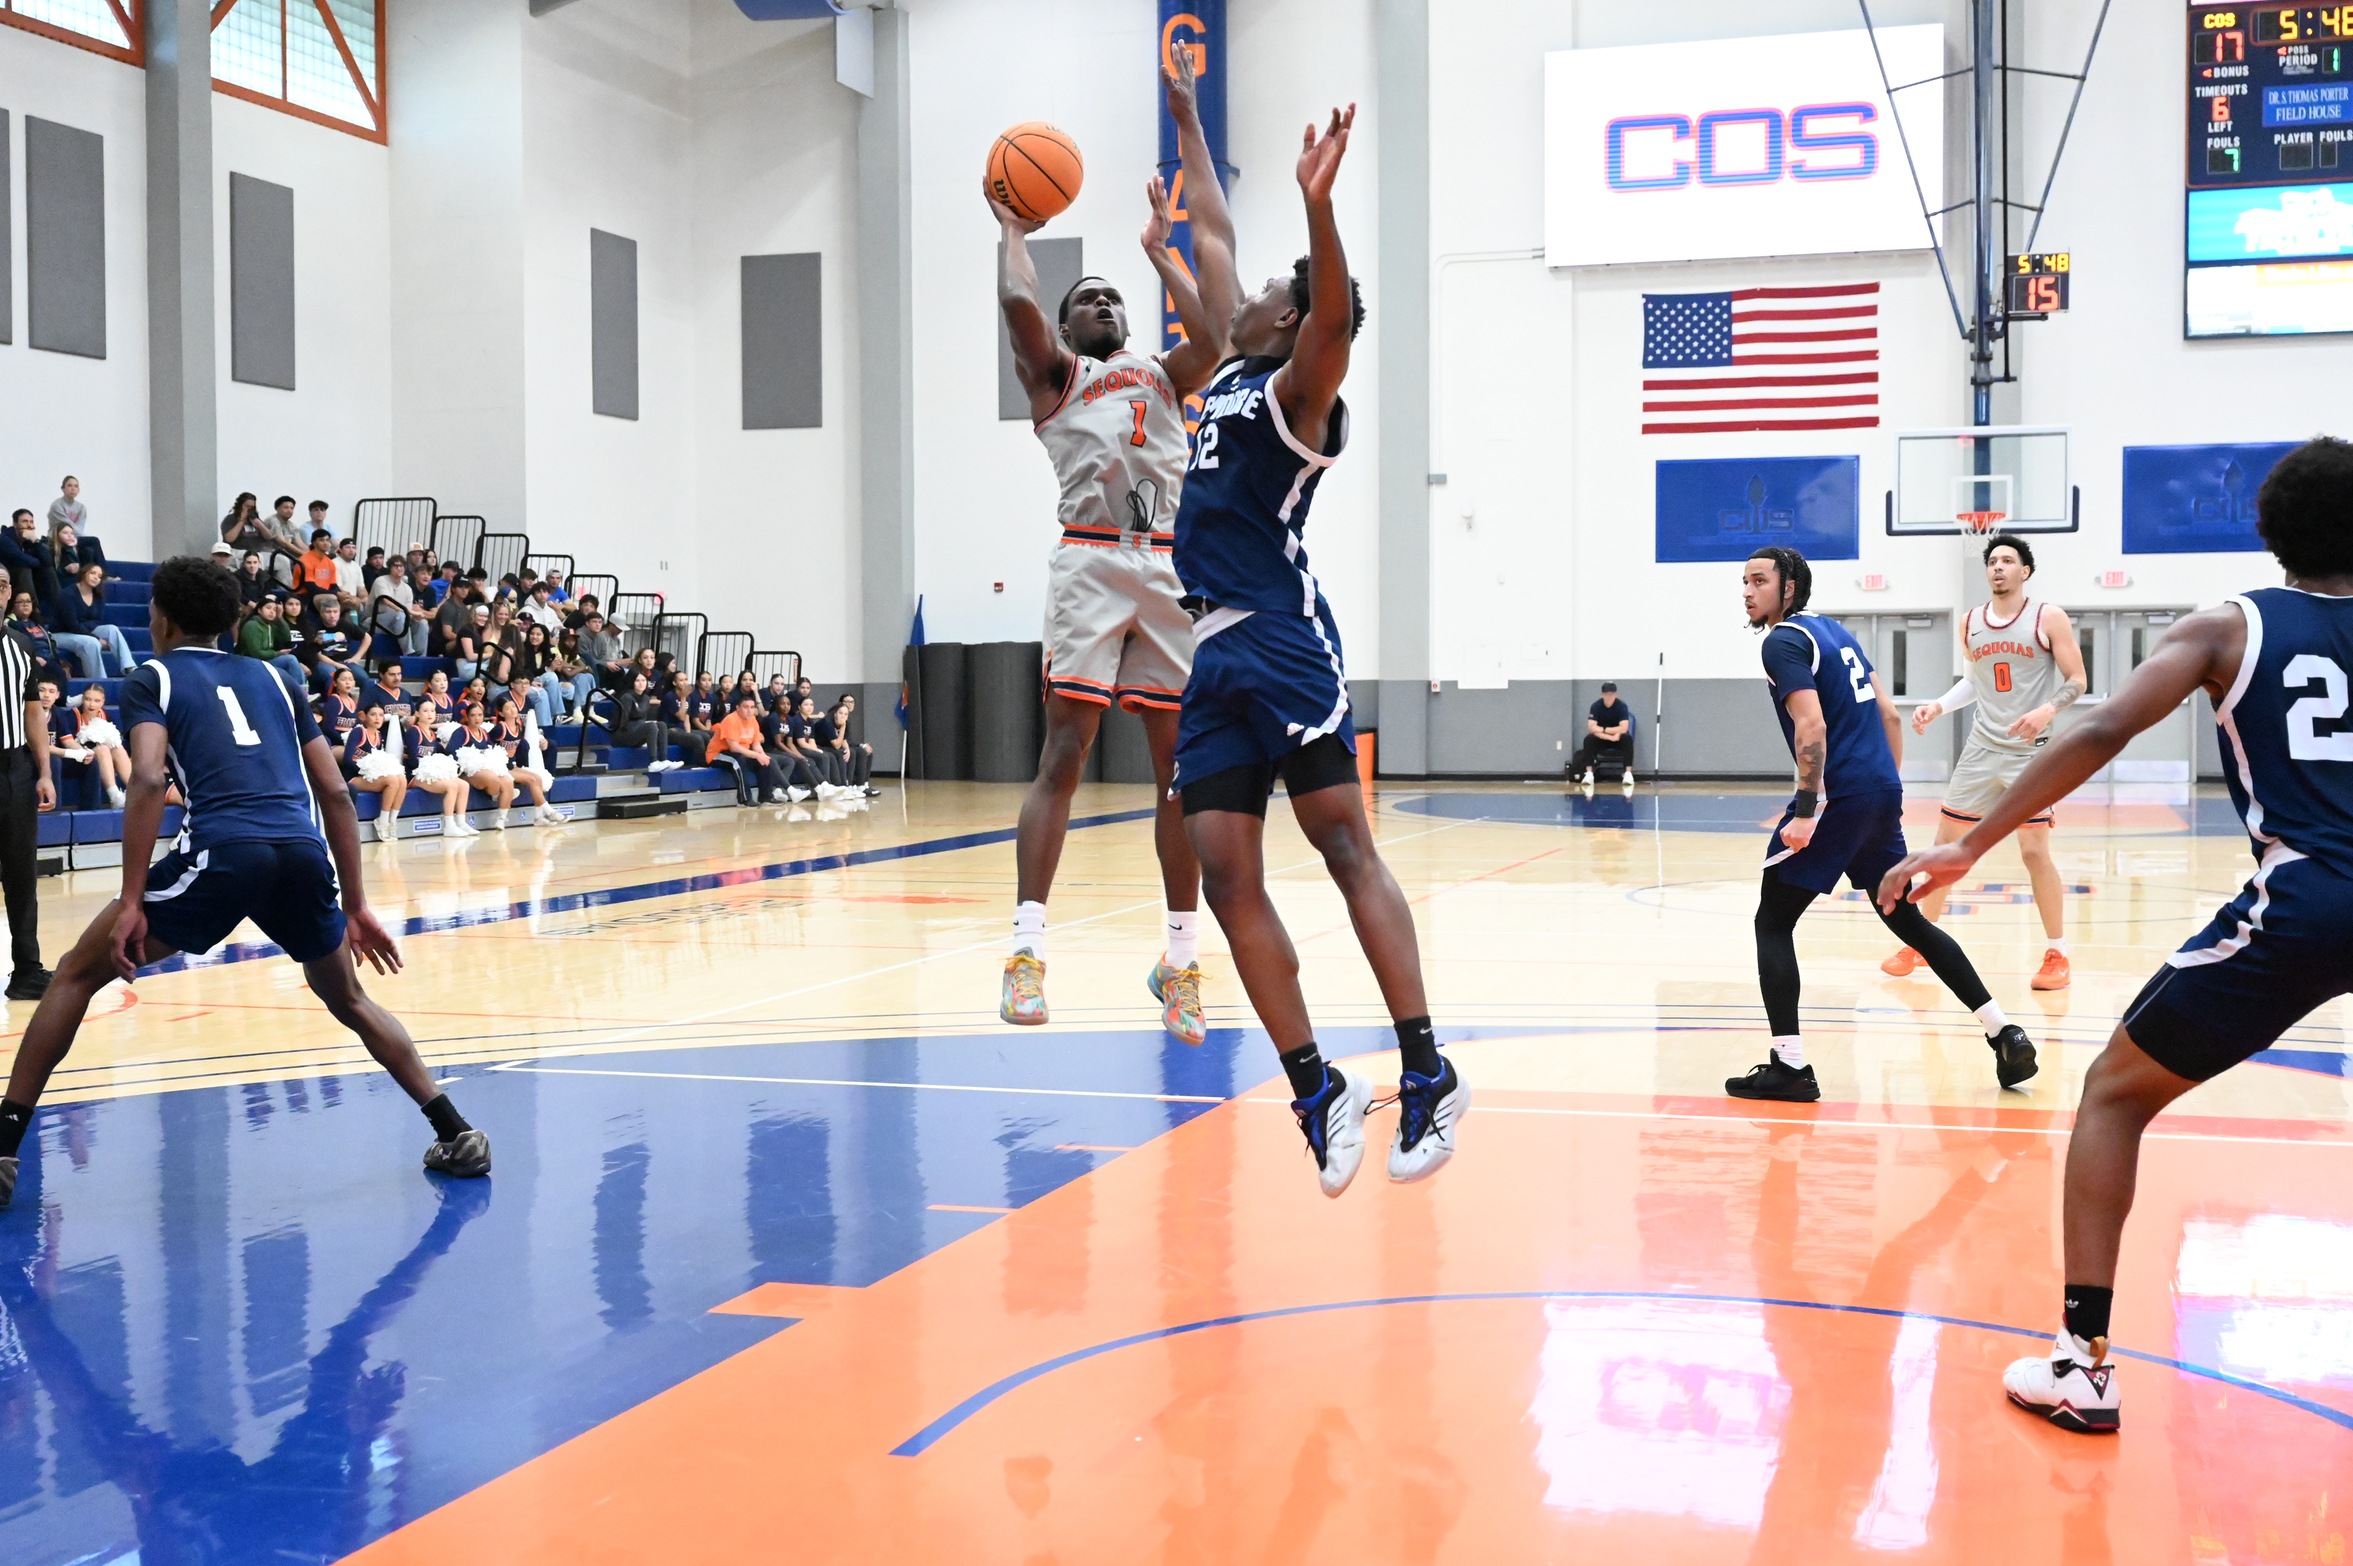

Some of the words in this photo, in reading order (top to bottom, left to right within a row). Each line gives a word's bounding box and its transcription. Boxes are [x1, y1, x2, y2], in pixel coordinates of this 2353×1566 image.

[2204, 12, 2236, 29] COS
[2215, 31, 2244, 62] 17
[2288, 44, 2309, 55] POSS
[2279, 53, 2318, 67] PERIOD
[2332, 47, 2339, 72] 1
[2213, 65, 2250, 79] BONUS
[2195, 84, 2248, 98] TIMEOUTS
[2288, 88, 2319, 104] THOMAS
[2320, 86, 2349, 102] PORTER
[2212, 96, 2230, 122] 6
[2276, 106, 2307, 121] FIELD
[2308, 104, 2342, 120] HOUSE
[2207, 121, 2233, 133] LEFT
[2207, 136, 2241, 149] FOULS
[2274, 132, 2314, 145] PLAYER
[2319, 129, 2353, 142] FOULS
[1604, 101, 1879, 193] COS
[2224, 148, 2239, 172] 7
[2017, 253, 2069, 274] 5:48
[2028, 276, 2058, 312] 15
[1129, 400, 1147, 448] 1
[1865, 574, 1883, 589] EXIT
[2105, 571, 2125, 585] EXIT
[1839, 646, 1877, 703] 2
[1993, 662, 2012, 693] 0
[215, 685, 262, 747] 1
